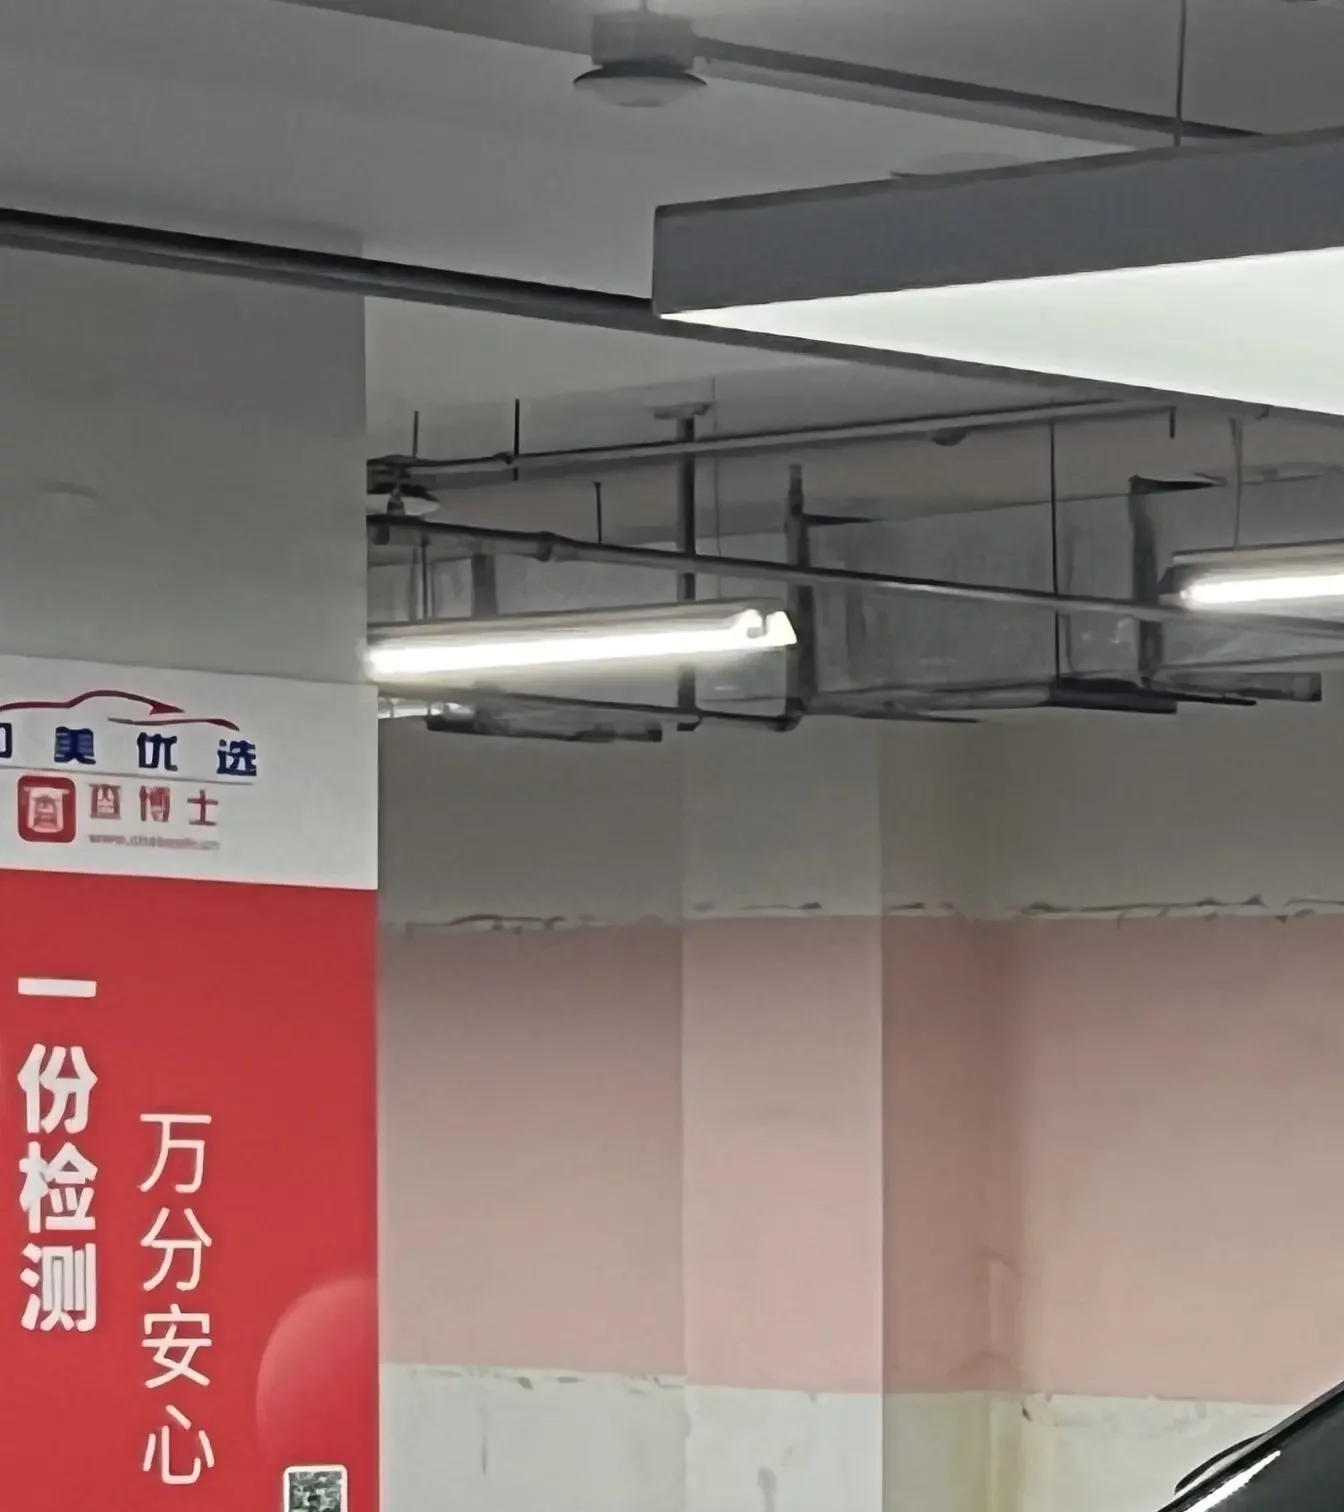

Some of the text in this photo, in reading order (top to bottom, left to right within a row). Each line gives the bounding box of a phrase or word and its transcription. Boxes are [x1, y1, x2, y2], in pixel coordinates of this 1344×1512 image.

[17, 977, 99, 1333] 一份检测
[137, 1112, 214, 1486] 万分安心
